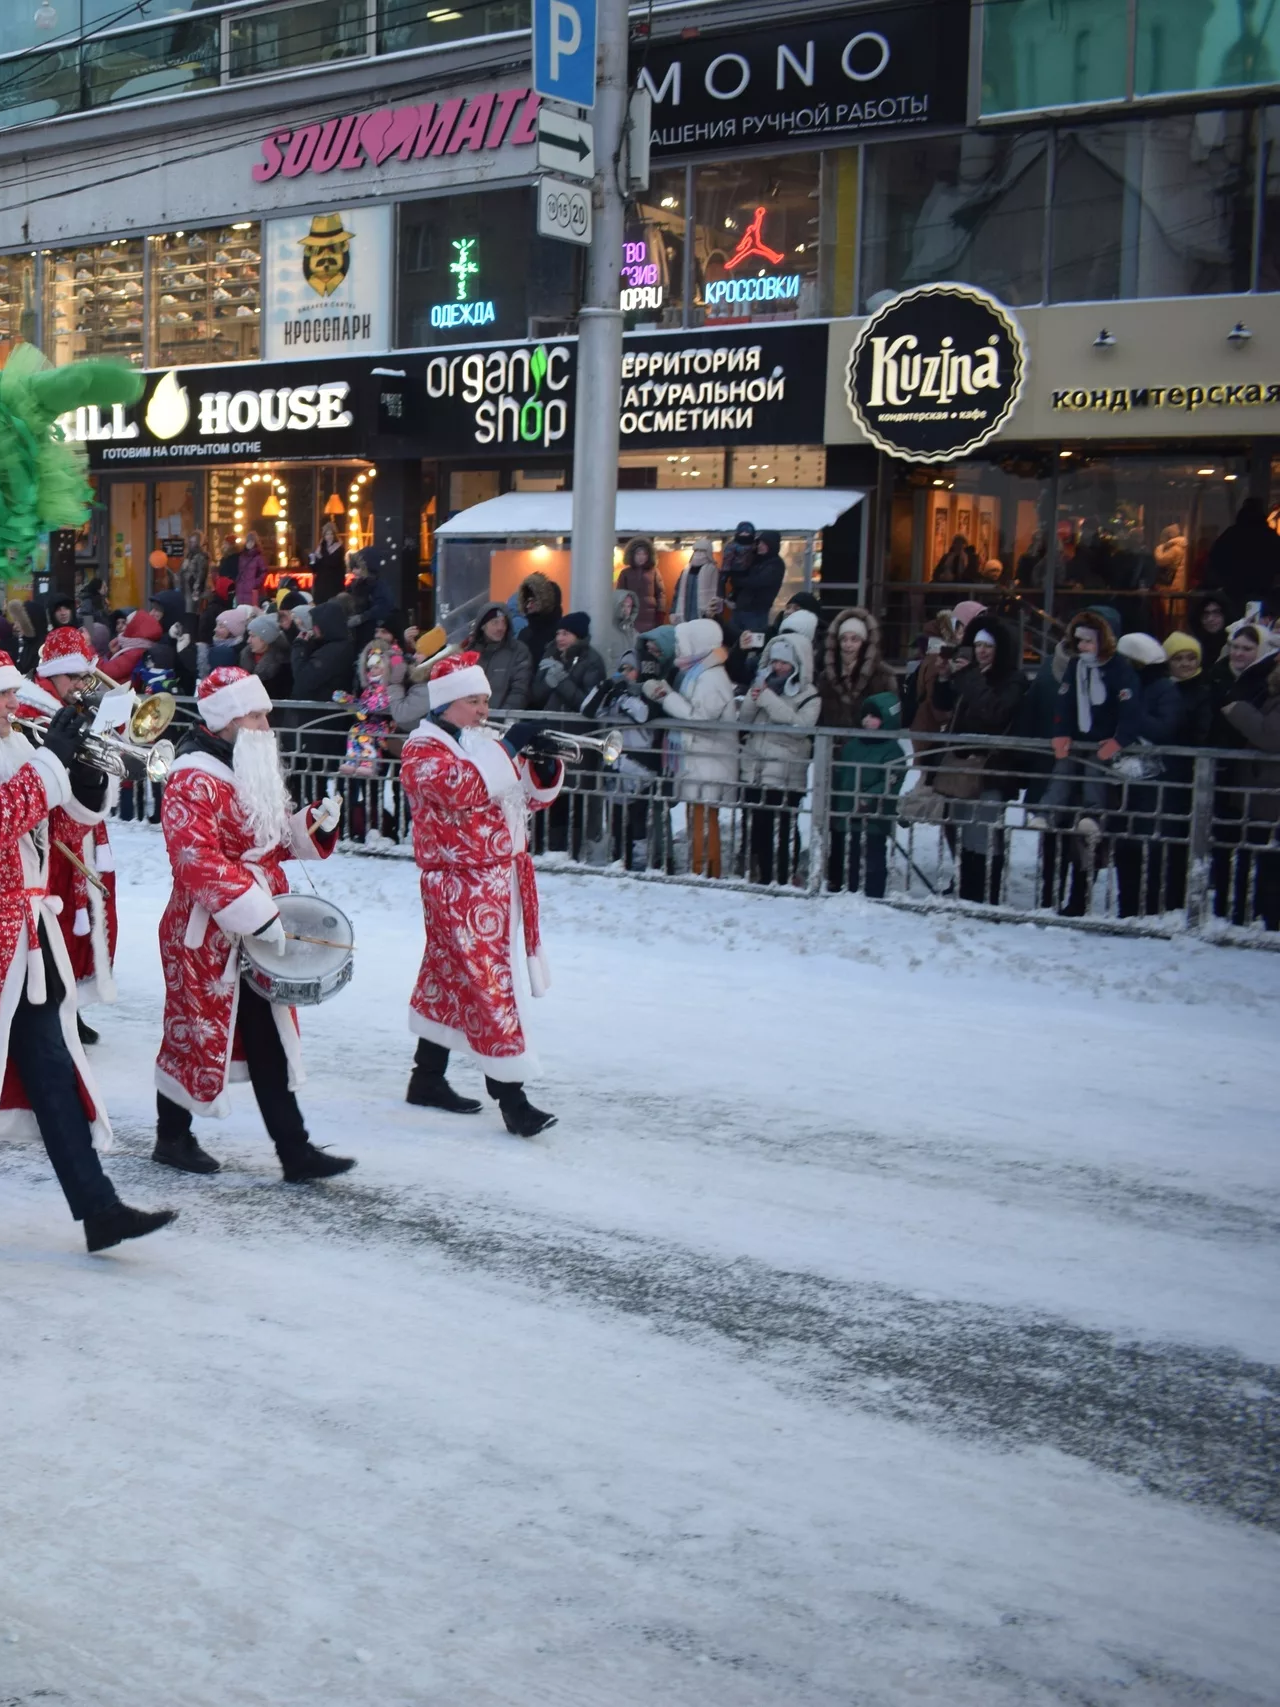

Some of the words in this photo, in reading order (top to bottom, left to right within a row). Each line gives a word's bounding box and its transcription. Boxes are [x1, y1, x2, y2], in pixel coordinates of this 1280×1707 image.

[550, 1, 582, 81] P
[637, 32, 890, 105] MONO
[742, 103, 829, 135] РУЧНОЙ
[836, 94, 928, 122] РАБОТЫ
[252, 114, 366, 182] SOUL
[559, 203, 568, 218] 15
[573, 205, 585, 224] 20
[622, 242, 646, 263] ВО
[705, 275, 800, 304] КРОССОВКИ
[431, 301, 495, 328] ОДЕЖДА
[427, 344, 570, 403] organic
[622, 345, 762, 378] ЕРРИТОРИЯ
[620, 367, 786, 408] АТУРАЛЬНОЙ
[1052, 384, 1280, 413] кондитерская
[198, 382, 353, 435] HOUSE
[475, 394, 567, 447] shop
[620, 406, 753, 434] ОСМЕТИКИ
[878, 411, 948, 422] кондитерская
[959, 408, 987, 421] кафе
[103, 447, 151, 459] ГОТОВИМ
[153, 445, 168, 456] НА
[170, 443, 229, 456] ОТКРЫТОМ
[232, 441, 261, 453] ОГНЕ
